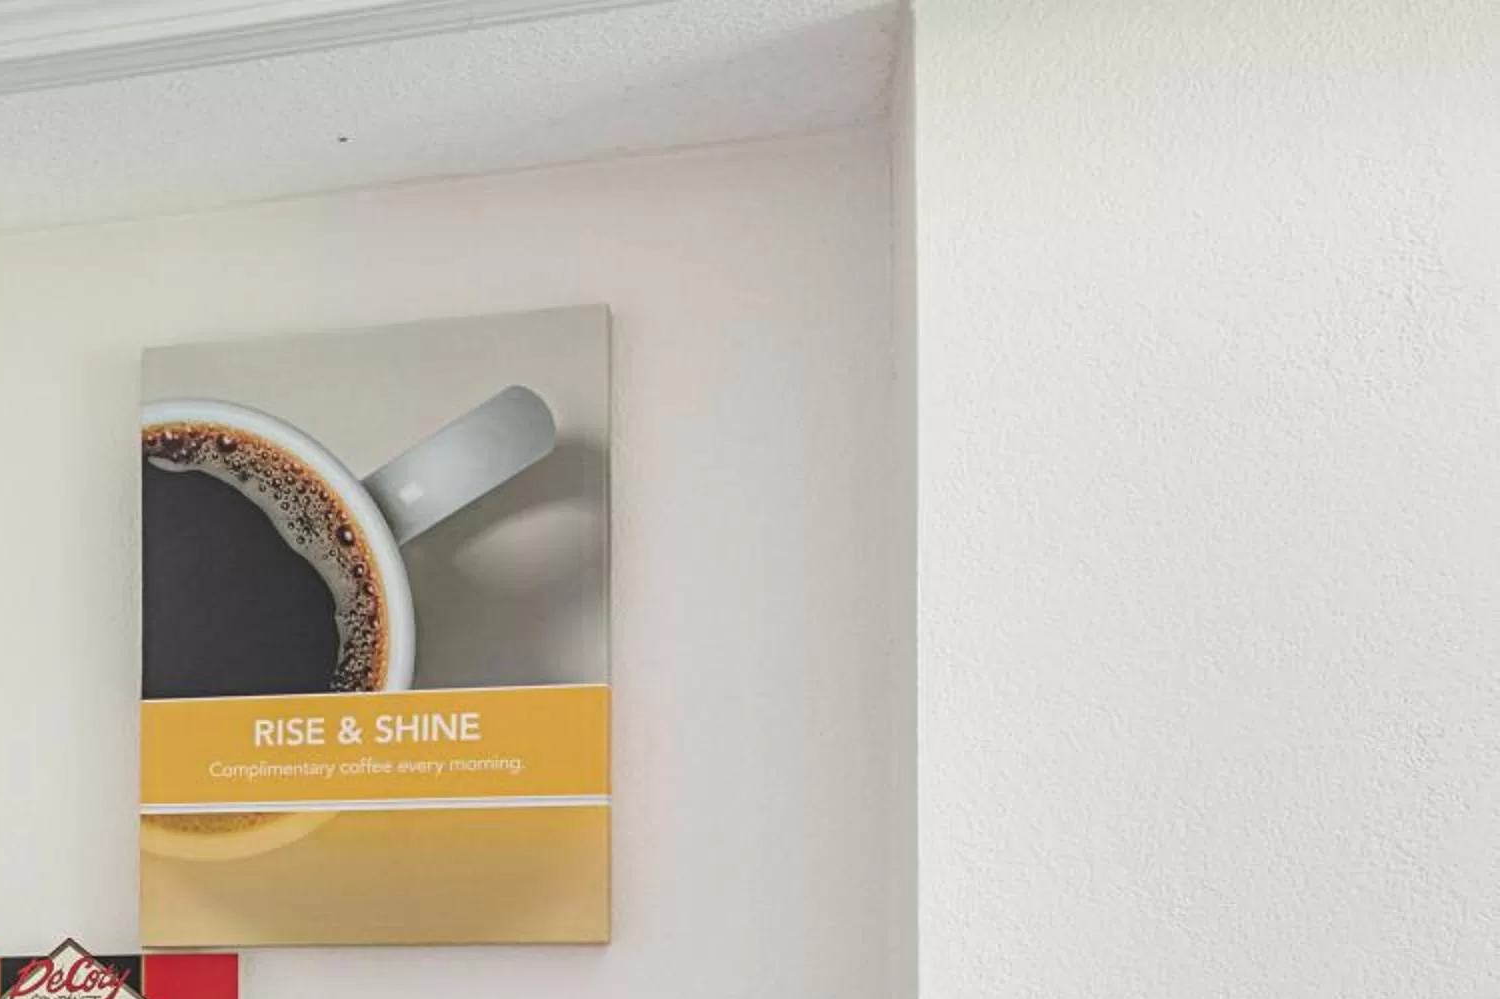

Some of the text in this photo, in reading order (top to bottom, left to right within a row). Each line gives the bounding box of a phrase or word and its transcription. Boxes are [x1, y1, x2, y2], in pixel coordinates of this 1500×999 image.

[254, 712, 481, 747] RISE & SHINE
[209, 753, 526, 780] Complimentary coffee every morning.
